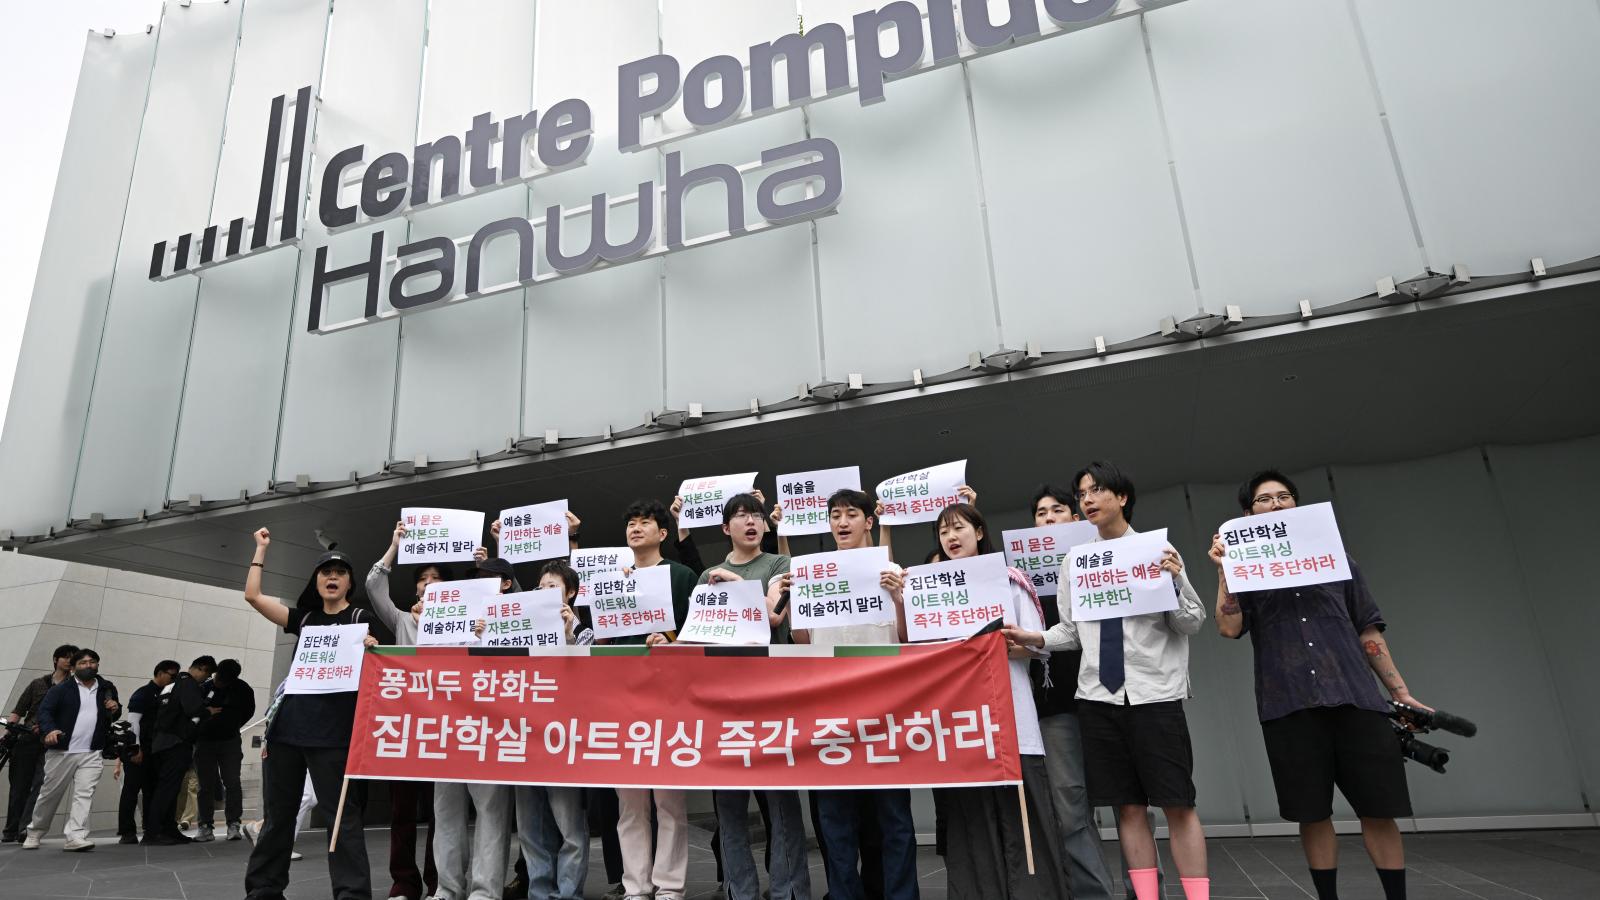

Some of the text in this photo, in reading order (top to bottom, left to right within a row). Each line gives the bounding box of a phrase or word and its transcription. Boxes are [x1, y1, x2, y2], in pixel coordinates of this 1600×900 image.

[319, 98, 591, 230] Centre
[308, 138, 844, 333] Hanwha
[782, 480, 815, 495] 예술을
[882, 482, 929, 500] 아트워싱
[684, 490, 723, 505] 자본으로
[784, 496, 828, 511] 기만하는
[684, 504, 724, 519] 예술하지
[885, 502, 907, 516] 즉각
[407, 514, 442, 526] 피 묻은
[504, 514, 532, 528] 예술을
[784, 510, 829, 526] 거부한다
[405, 528, 449, 540] 자본으로
[504, 523, 562, 541] 기만하는 예술
[1224, 522, 1288, 546] 집단학살
[405, 540, 475, 554] 예술하지 말라
[504, 541, 542, 555] 거부한다
[1011, 536, 1055, 553] 피 묻은
[1229, 540, 1292, 563] 아트워싱
[576, 554, 618, 568] 집단학살
[1076, 550, 1114, 568] 예술을
[796, 562, 838, 580] 피 묻은
[1076, 562, 1162, 589] 기만하는 예술
[1233, 554, 1336, 581] 즉각 중단하라
[594, 579, 636, 596] 집단학살
[910, 570, 966, 591] 집단학살
[427, 590, 460, 604] 피 묻은
[798, 580, 850, 599] 자본으로
[595, 596, 637, 611] 아트워싱
[696, 592, 728, 606] 예술을
[912, 588, 969, 609] 아트워싱
[1079, 588, 1132, 610] 거부한다
[425, 605, 467, 618] 자본으로
[488, 602, 522, 618] 피 묻은
[694, 608, 763, 622] 기만하는 예술
[798, 596, 884, 618] 예술하지 말라
[598, 608, 666, 628] 즉각 중단하라
[914, 604, 1006, 629] 즉각 중단하라
[424, 620, 466, 634] 예술하지
[488, 618, 532, 634] 자본으로
[688, 625, 736, 638] 거부한다
[304, 634, 340, 648] 집단학살
[536, 632, 558, 646] 말라
[300, 651, 336, 664] 아트워싱
[295, 665, 352, 680] 즉각 중단하라
[378, 668, 559, 704] 퐁피두 한화는
[372, 704, 1000, 768] 집단학살 아트워싱 즉각 중단하라
